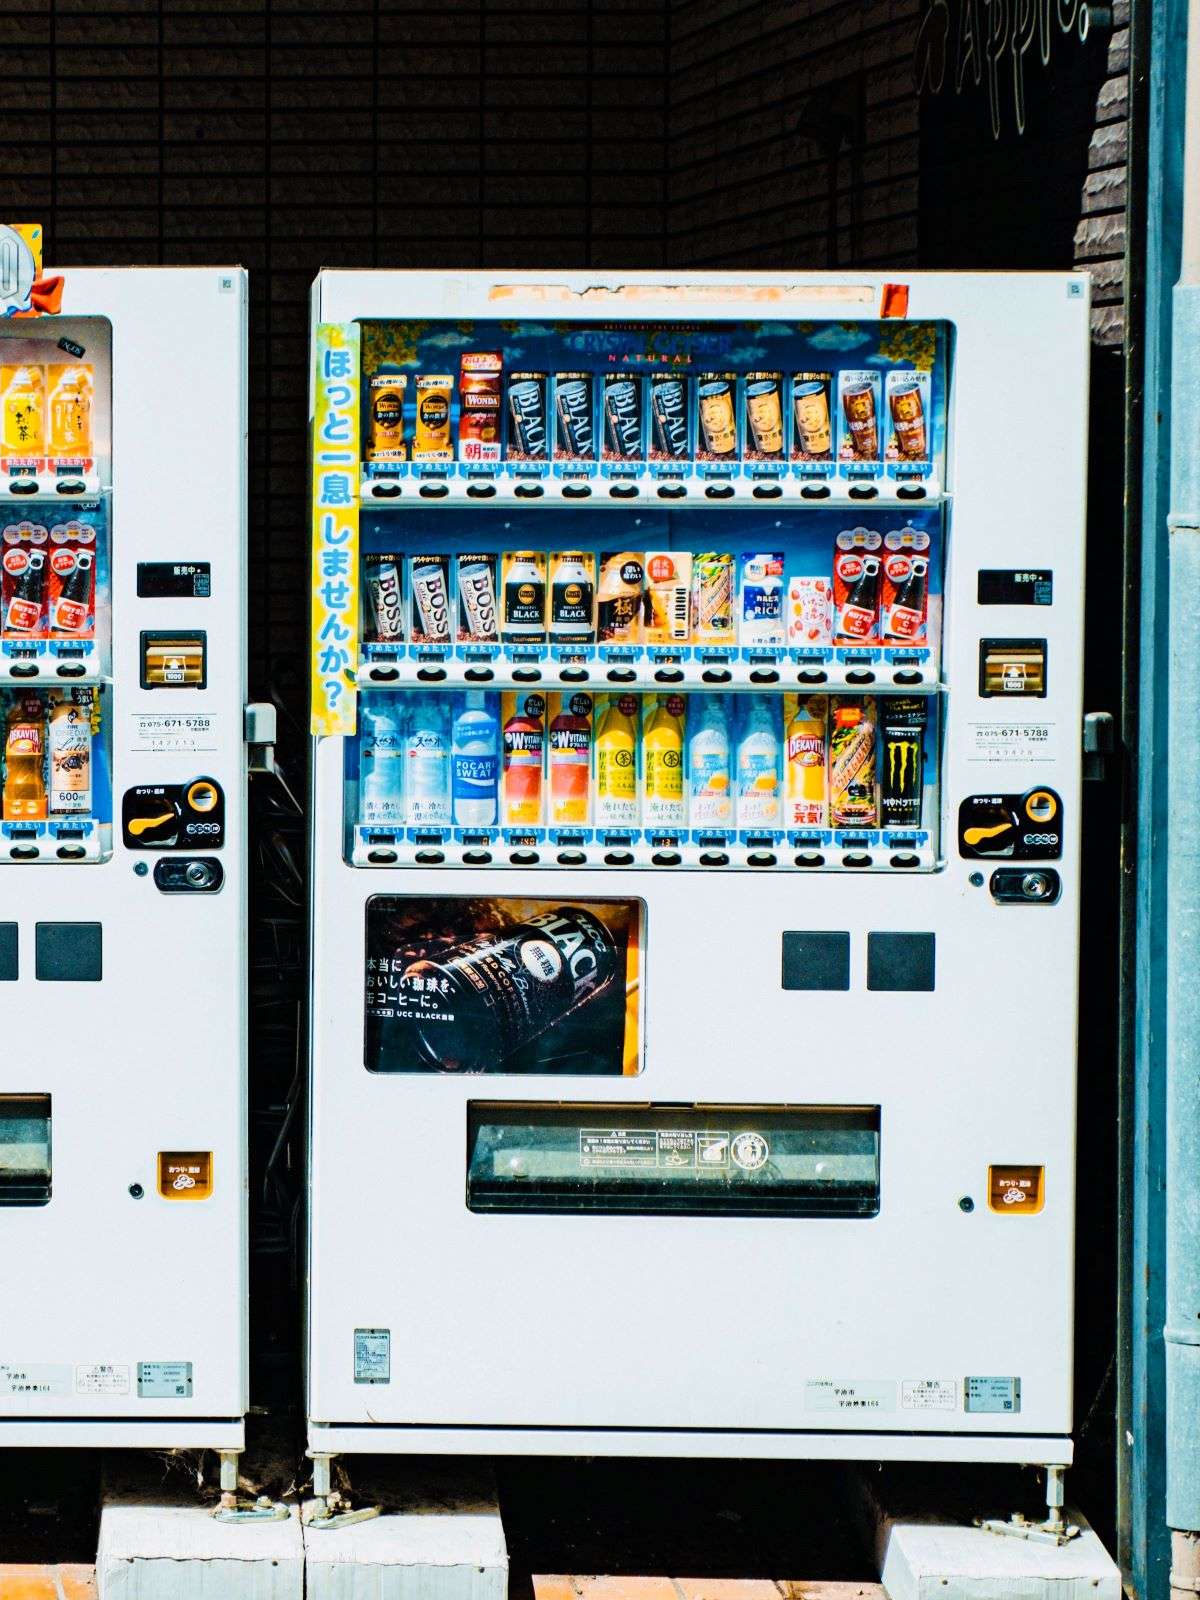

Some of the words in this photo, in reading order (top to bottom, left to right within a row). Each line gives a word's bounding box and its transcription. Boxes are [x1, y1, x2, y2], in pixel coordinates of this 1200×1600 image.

[607, 354, 693, 363] NATURAL
[468, 395, 498, 405] WONDA
[517, 391, 547, 454] BLACK
[566, 390, 593, 454] BLACK
[614, 390, 642, 455] BLACK
[662, 390, 689, 454] BLACK
[173, 566, 196, 575] 販売中
[1014, 573, 1038, 582] 販売中
[379, 577, 402, 633] BOSS
[426, 577, 449, 633] BOSS
[472, 577, 496, 633] BOSS
[513, 610, 540, 618] BLACK
[559, 610, 585, 618] BLACK
[755, 607, 780, 615] RICH
[456, 761, 495, 769] POCARI
[456, 769, 491, 777] SWEAT
[793, 812, 823, 824] 元気!
[527, 913, 597, 1001] BLACK
[396, 1011, 413, 1019] UCC
